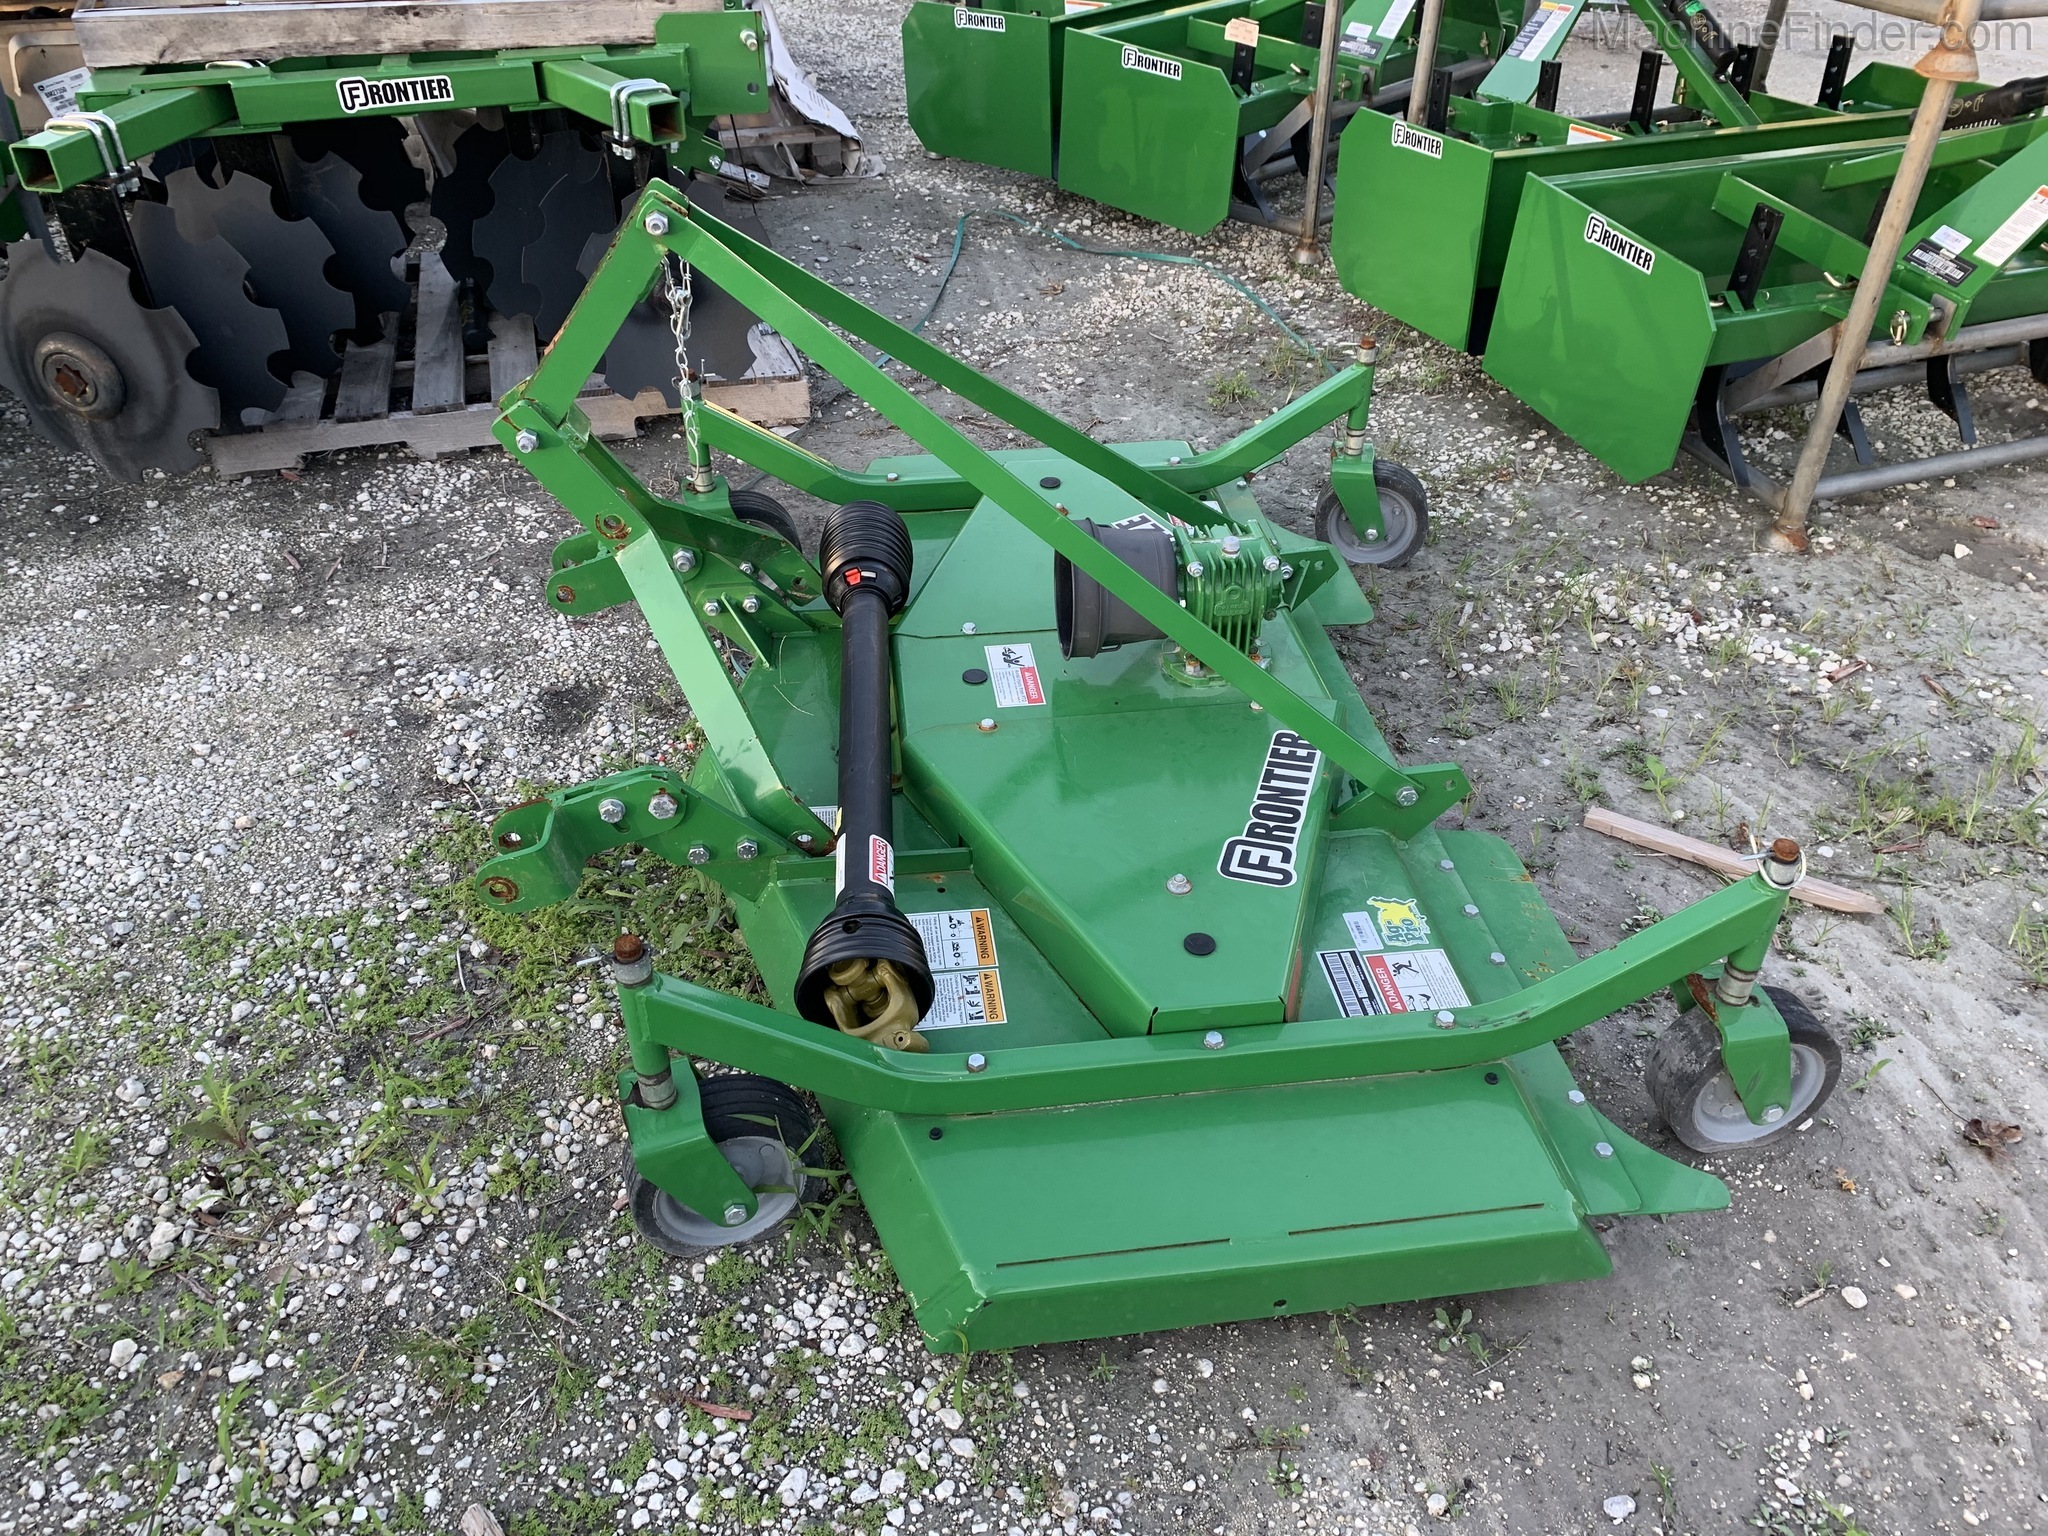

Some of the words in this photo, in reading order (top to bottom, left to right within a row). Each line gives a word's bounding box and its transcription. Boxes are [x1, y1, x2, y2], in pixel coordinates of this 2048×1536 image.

[955, 9, 1005, 30] FRONTIER
[1123, 47, 1181, 78] FRONTIER
[339, 79, 452, 110] FRONTIER
[1393, 122, 1442, 156] FRONTIER
[1586, 215, 1653, 271] FRONTIER
[1026, 674, 1039, 700] DANGER
[1220, 732, 1318, 886] FRONTIER
[876, 840, 887, 874] DANGER
[975, 927, 990, 959] WARNING
[984, 980, 999, 1020] WARNING
[1376, 967, 1398, 1002] DANGER
